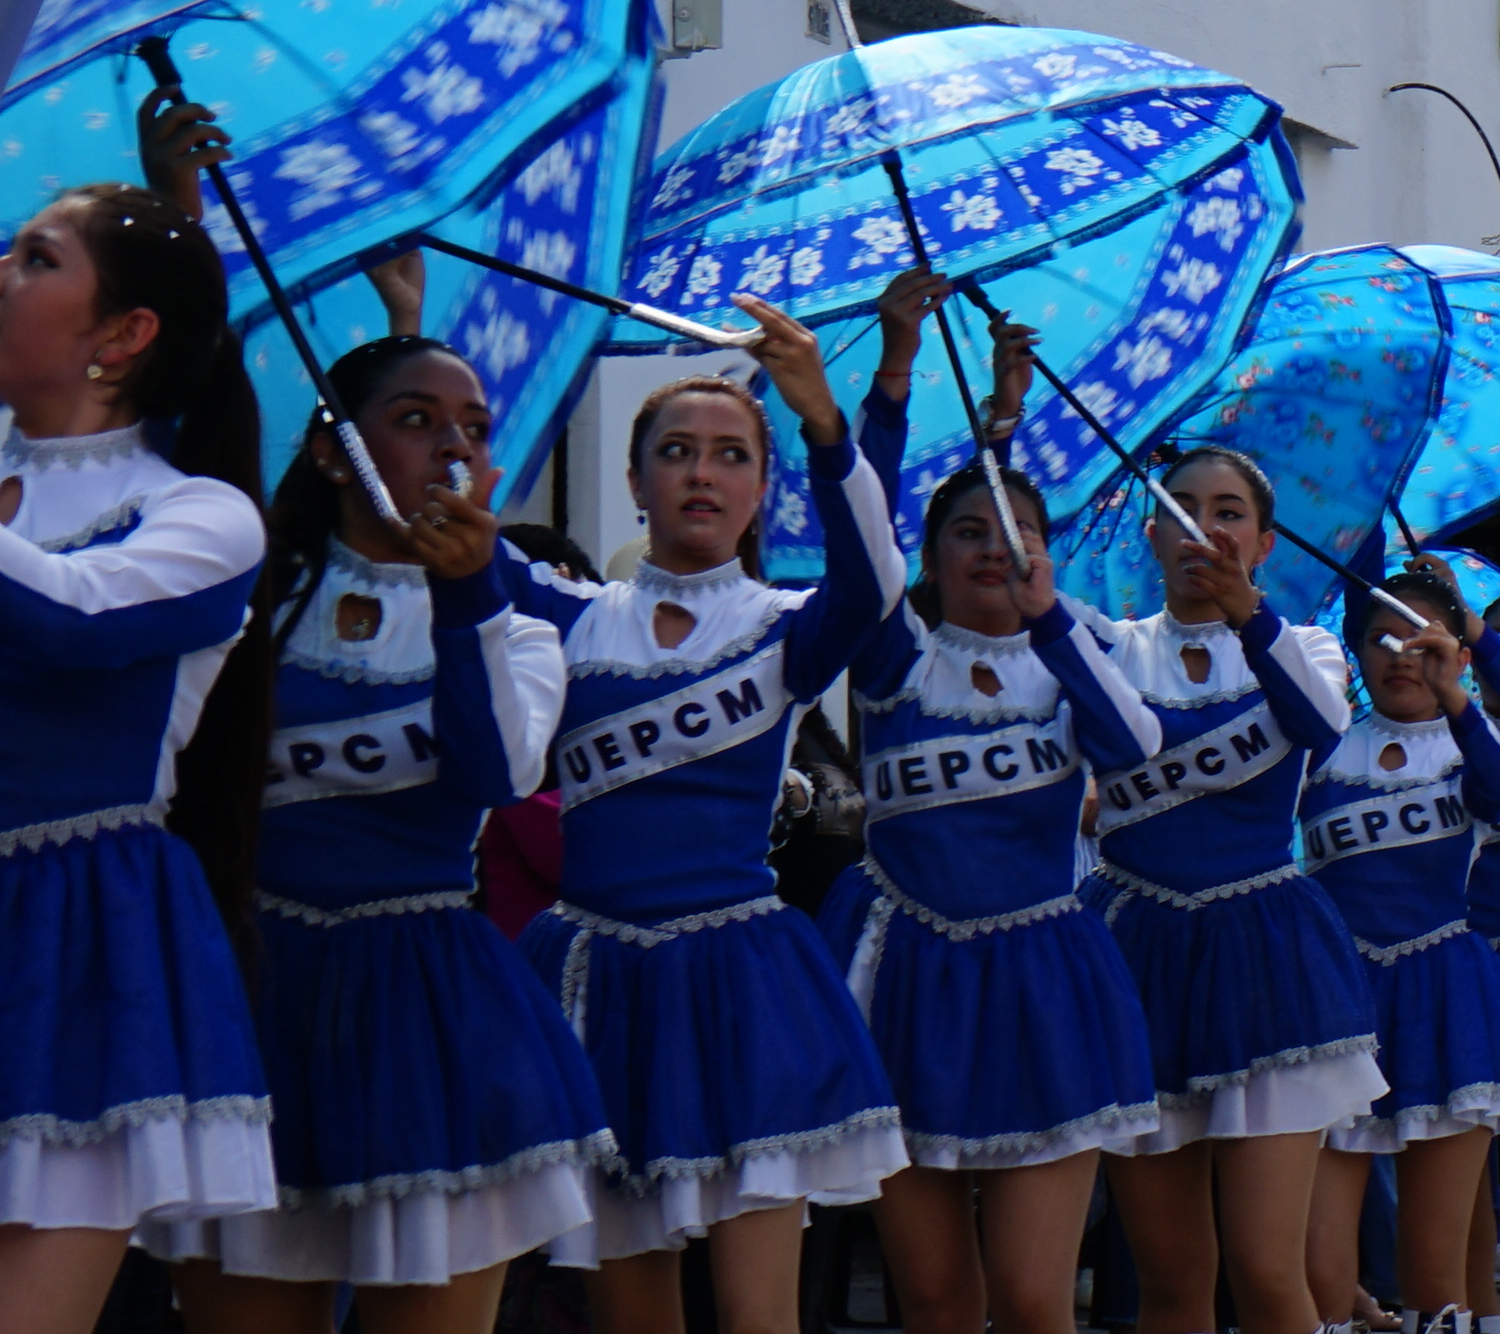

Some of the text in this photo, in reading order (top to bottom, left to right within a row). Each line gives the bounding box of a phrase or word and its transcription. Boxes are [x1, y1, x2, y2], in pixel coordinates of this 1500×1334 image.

[564, 678, 765, 783] UEPCM
[1107, 722, 1270, 811] UEPCM
[876, 738, 1068, 801] UEPCM
[1308, 795, 1465, 860] UEPCM
